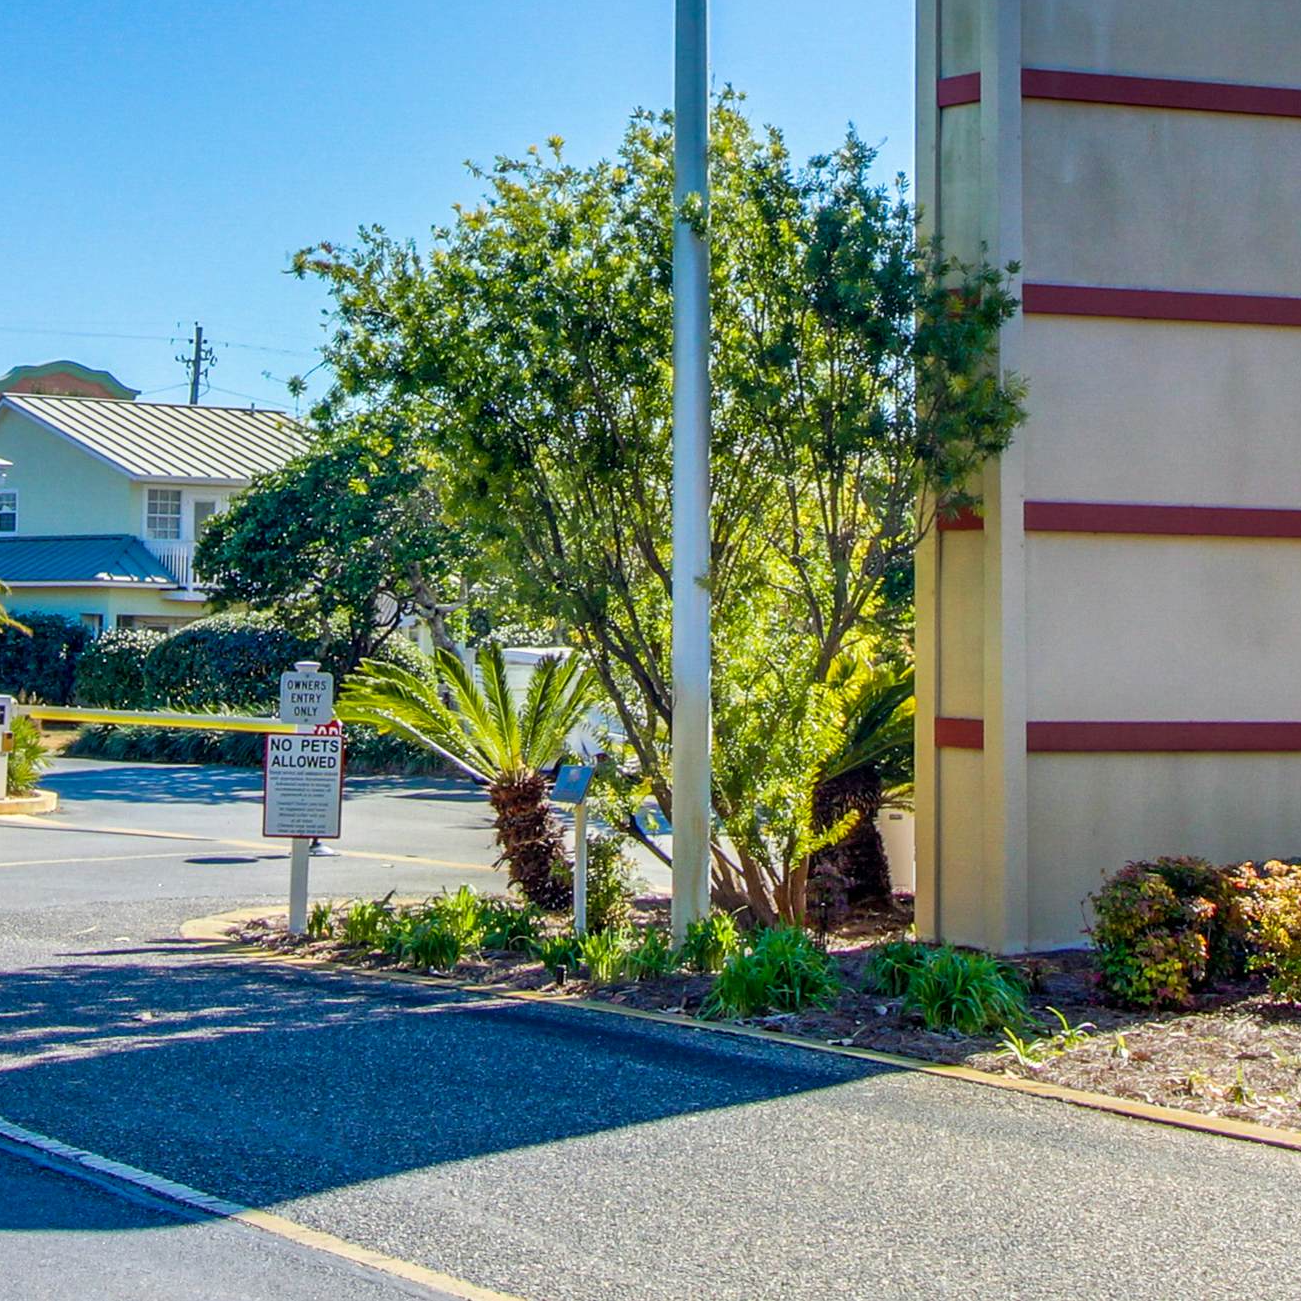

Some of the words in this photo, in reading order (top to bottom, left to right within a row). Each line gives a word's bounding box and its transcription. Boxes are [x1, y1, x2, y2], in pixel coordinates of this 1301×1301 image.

[287, 679, 327, 691] OWNERS
[291, 692, 323, 704] ENTRY
[294, 705, 318, 717] ONLY
[270, 738, 293, 752] NO
[301, 739, 339, 753] PETS
[271, 755, 337, 769] ALLOWED
